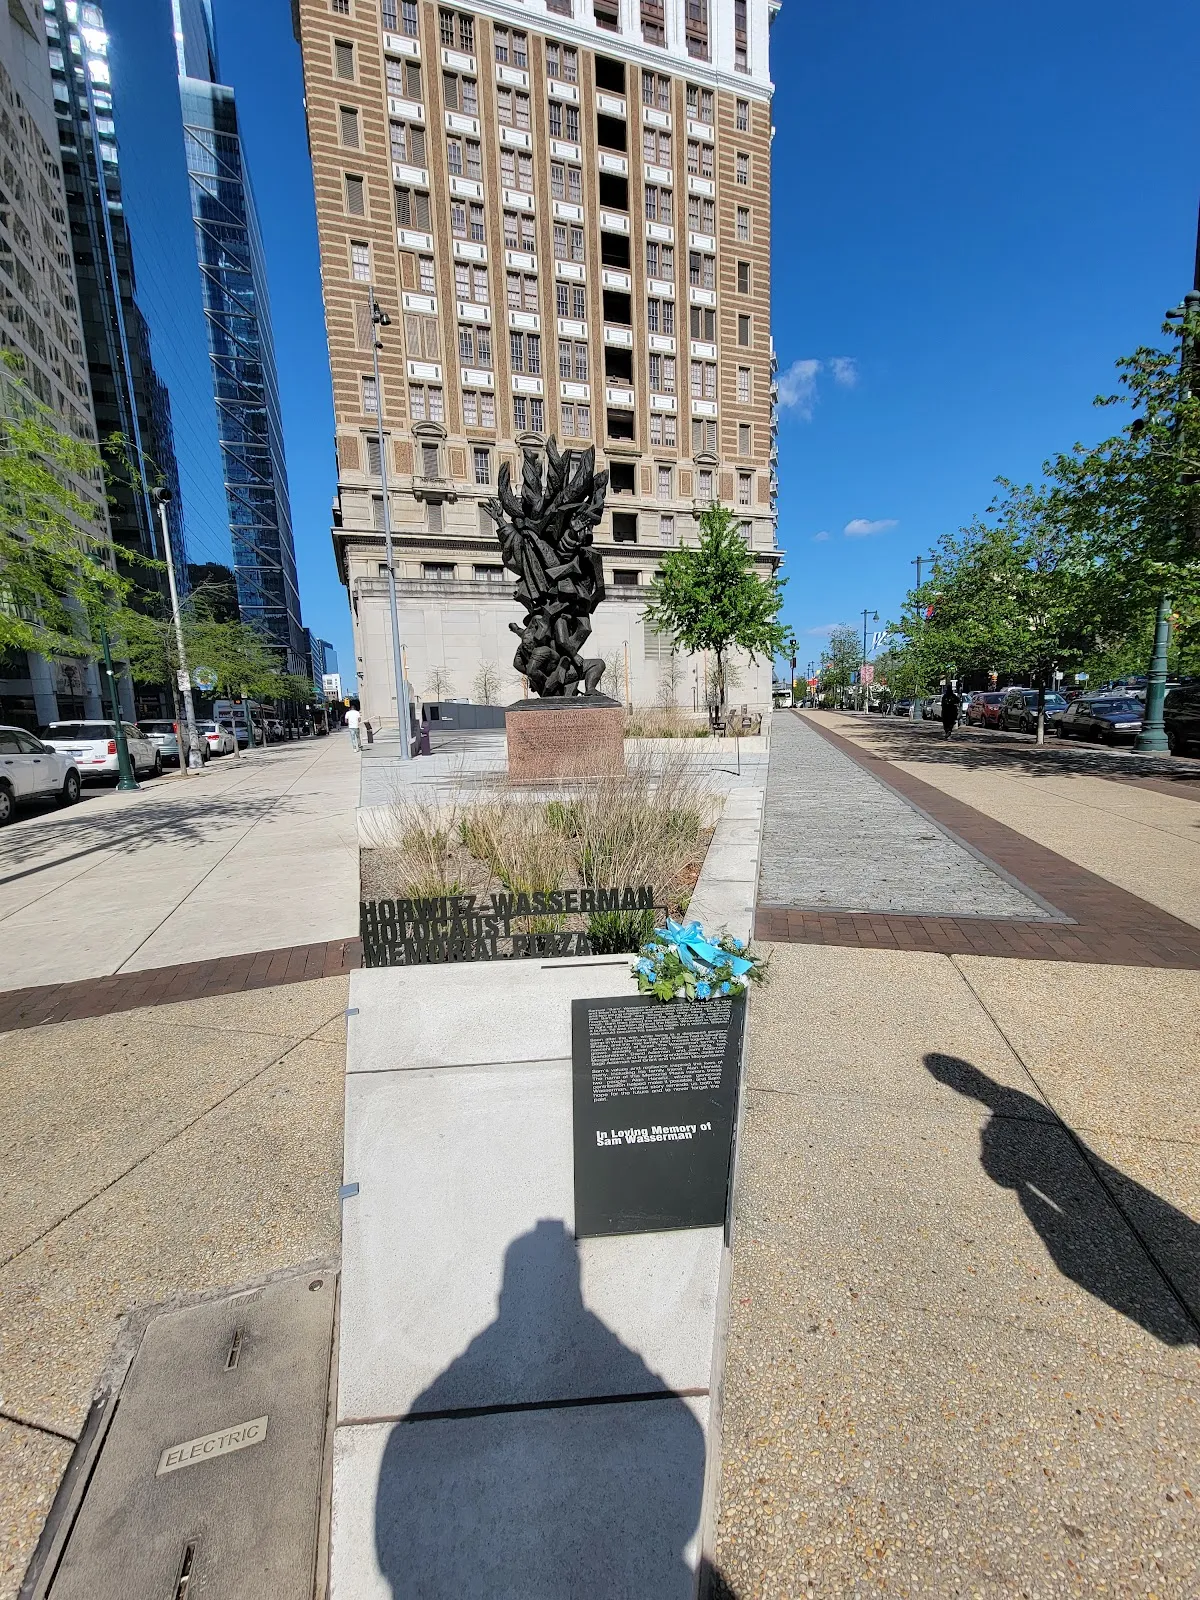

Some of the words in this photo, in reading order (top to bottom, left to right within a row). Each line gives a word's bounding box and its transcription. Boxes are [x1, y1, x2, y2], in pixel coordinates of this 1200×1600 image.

[361, 916, 510, 945] HOLOCAUST
[365, 937, 503, 968] MEMORIAL
[512, 932, 593, 957] PLAZA
[596, 1130, 608, 1139] In
[611, 1127, 648, 1139] Loving
[651, 1124, 696, 1134] Memory
[700, 1122, 712, 1130] of
[596, 1137, 622, 1146] Sam
[625, 1132, 692, 1144] Wasserman
[165, 1425, 260, 1467] ELECTRIC
